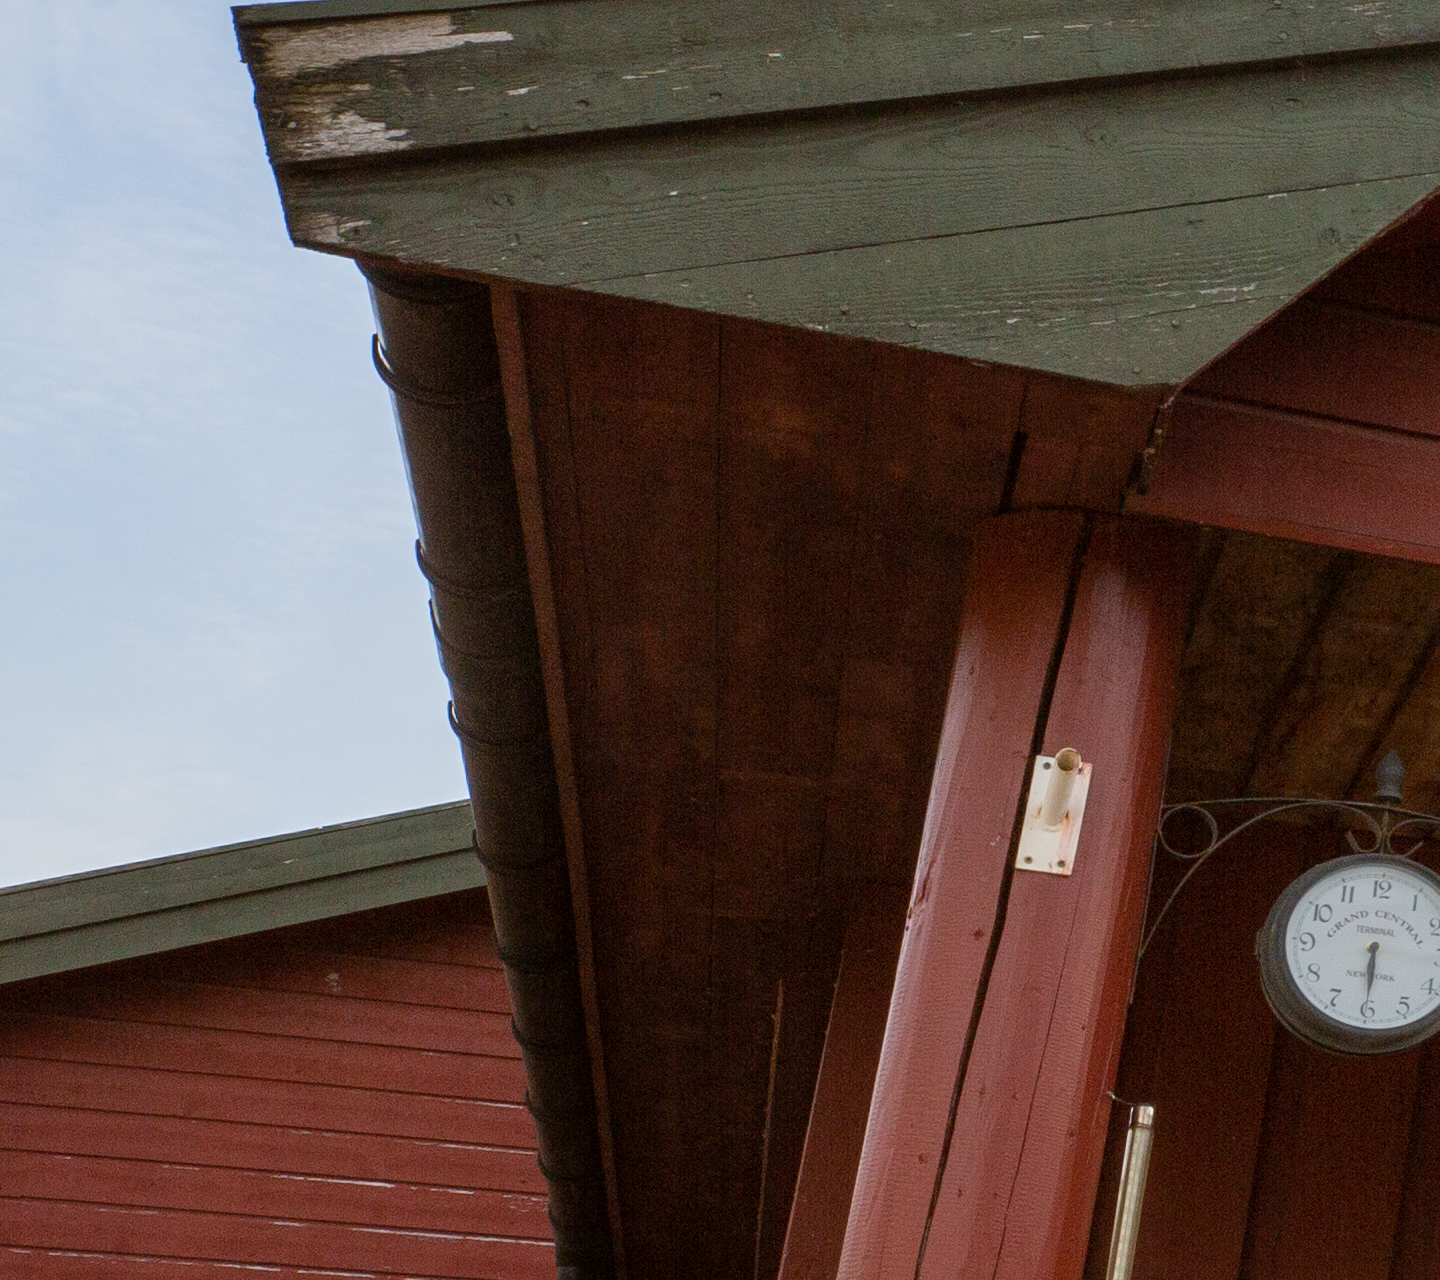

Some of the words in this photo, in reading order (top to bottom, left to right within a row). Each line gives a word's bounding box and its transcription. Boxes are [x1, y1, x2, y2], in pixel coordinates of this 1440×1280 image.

[1341, 885, 1355, 904] 11
[1372, 879, 1392, 900] 12
[1412, 894, 1418, 912] 1
[1312, 903, 1333, 923] 10
[1327, 909, 1369, 938] GRAND
[1375, 909, 1424, 950] CENTRAL
[1356, 924, 1395, 938] TERMINAL
[1300, 931, 1316, 952] 9
[1306, 962, 1321, 983] 8
[1374, 972, 1395, 982] ORK
[1420, 978, 1436, 996] 4
[1329, 988, 1342, 1007] 7
[1395, 996, 1410, 1017] 5
[1360, 1000, 1375, 1019] 6
